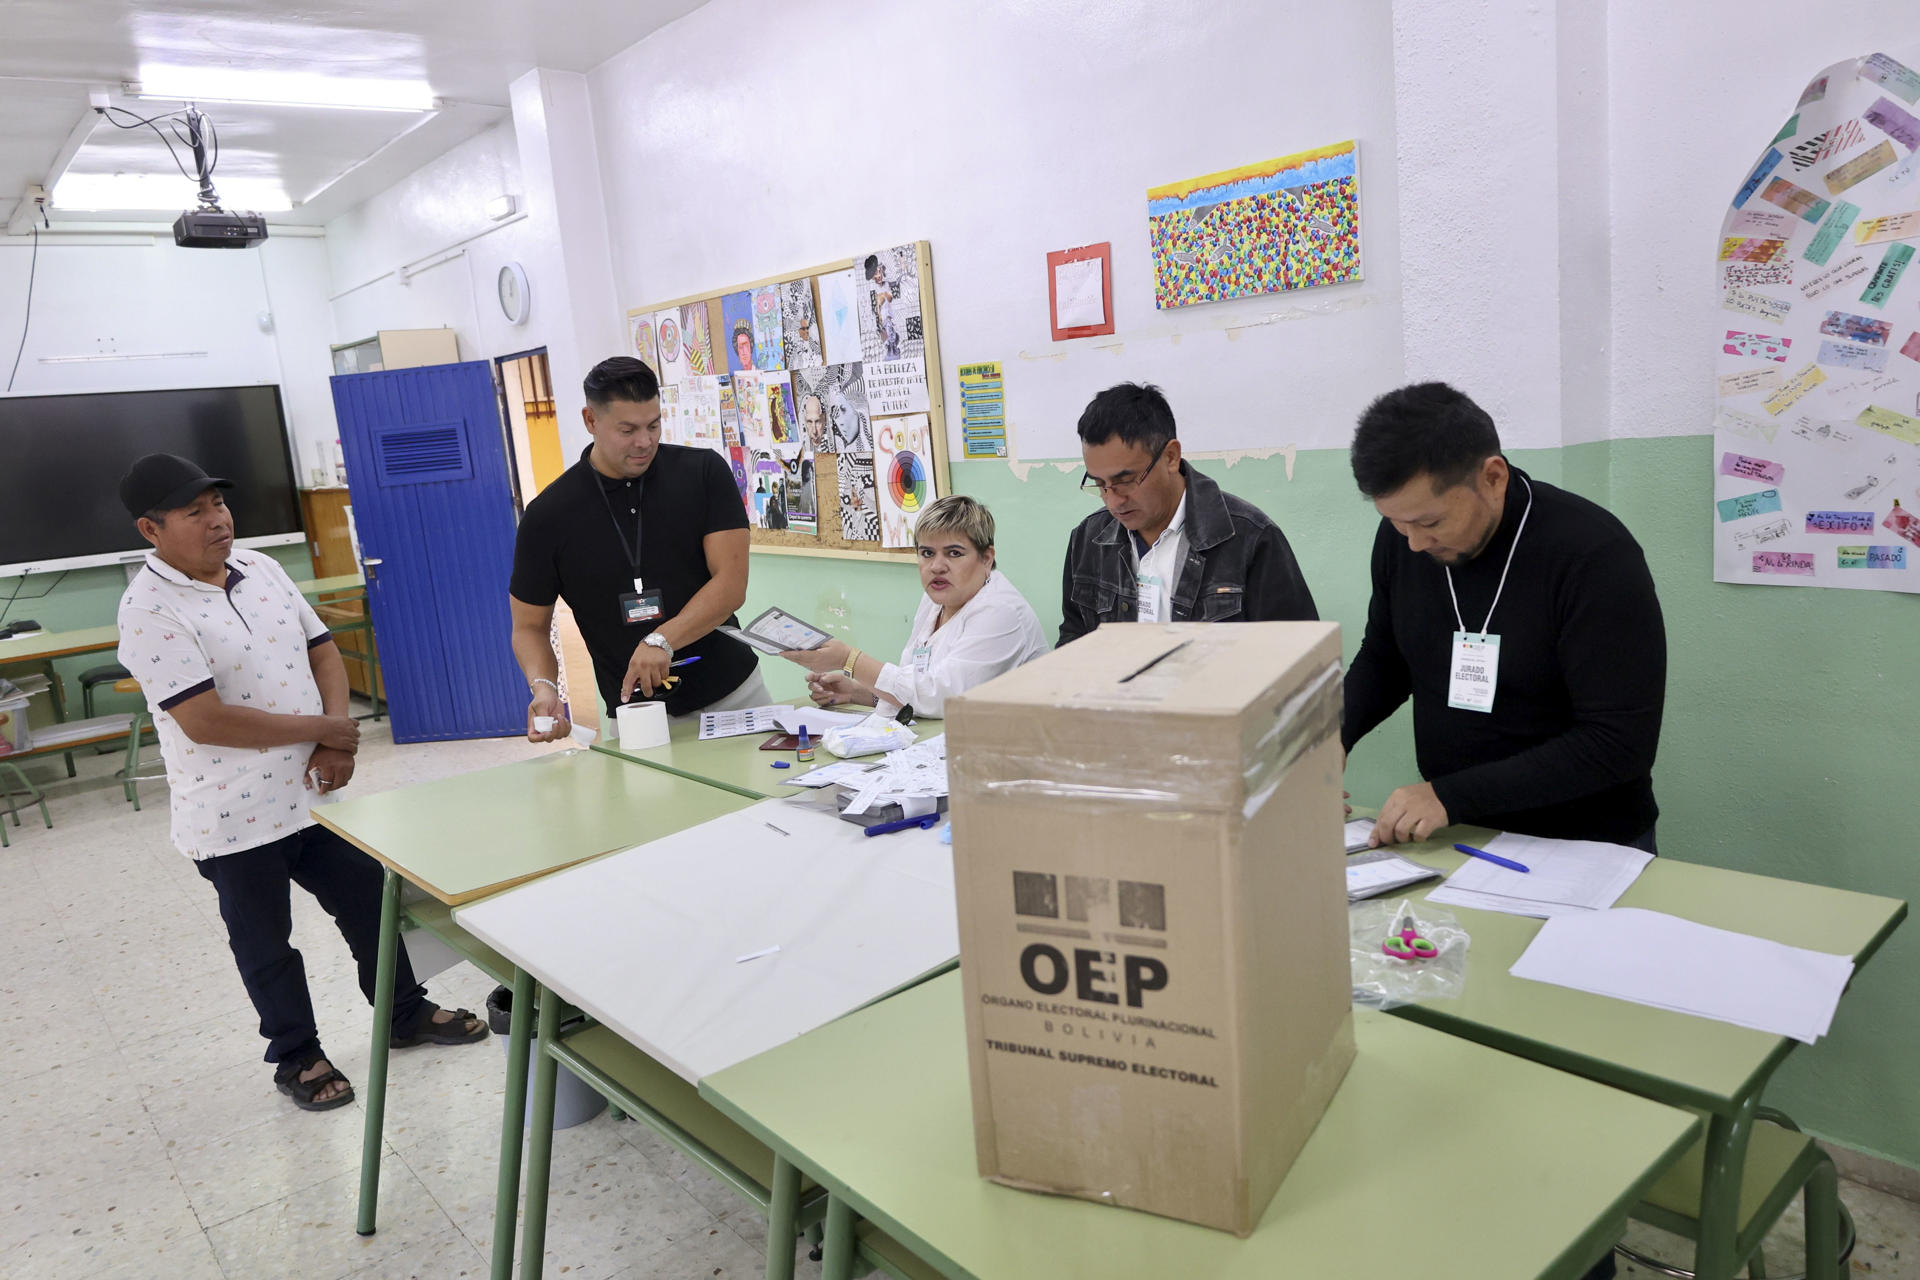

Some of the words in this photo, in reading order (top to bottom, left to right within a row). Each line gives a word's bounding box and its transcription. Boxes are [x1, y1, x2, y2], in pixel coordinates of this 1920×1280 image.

[1869, 553, 1902, 562] PASADO
[1455, 672, 1489, 683] ELECTORAL
[1460, 665, 1484, 674] JURADO
[1020, 943, 1168, 1008] OEP
[1036, 1001, 1108, 1022] ELECTORAL
[1112, 1012, 1217, 1039] PLURINACIONAL
[1044, 1020, 1157, 1049] BOLIVIA
[986, 1039, 1055, 1059] TRIBUNAL
[1058, 1050, 1127, 1072] SUPREMO
[1132, 1063, 1219, 1088] ELECTORAL
